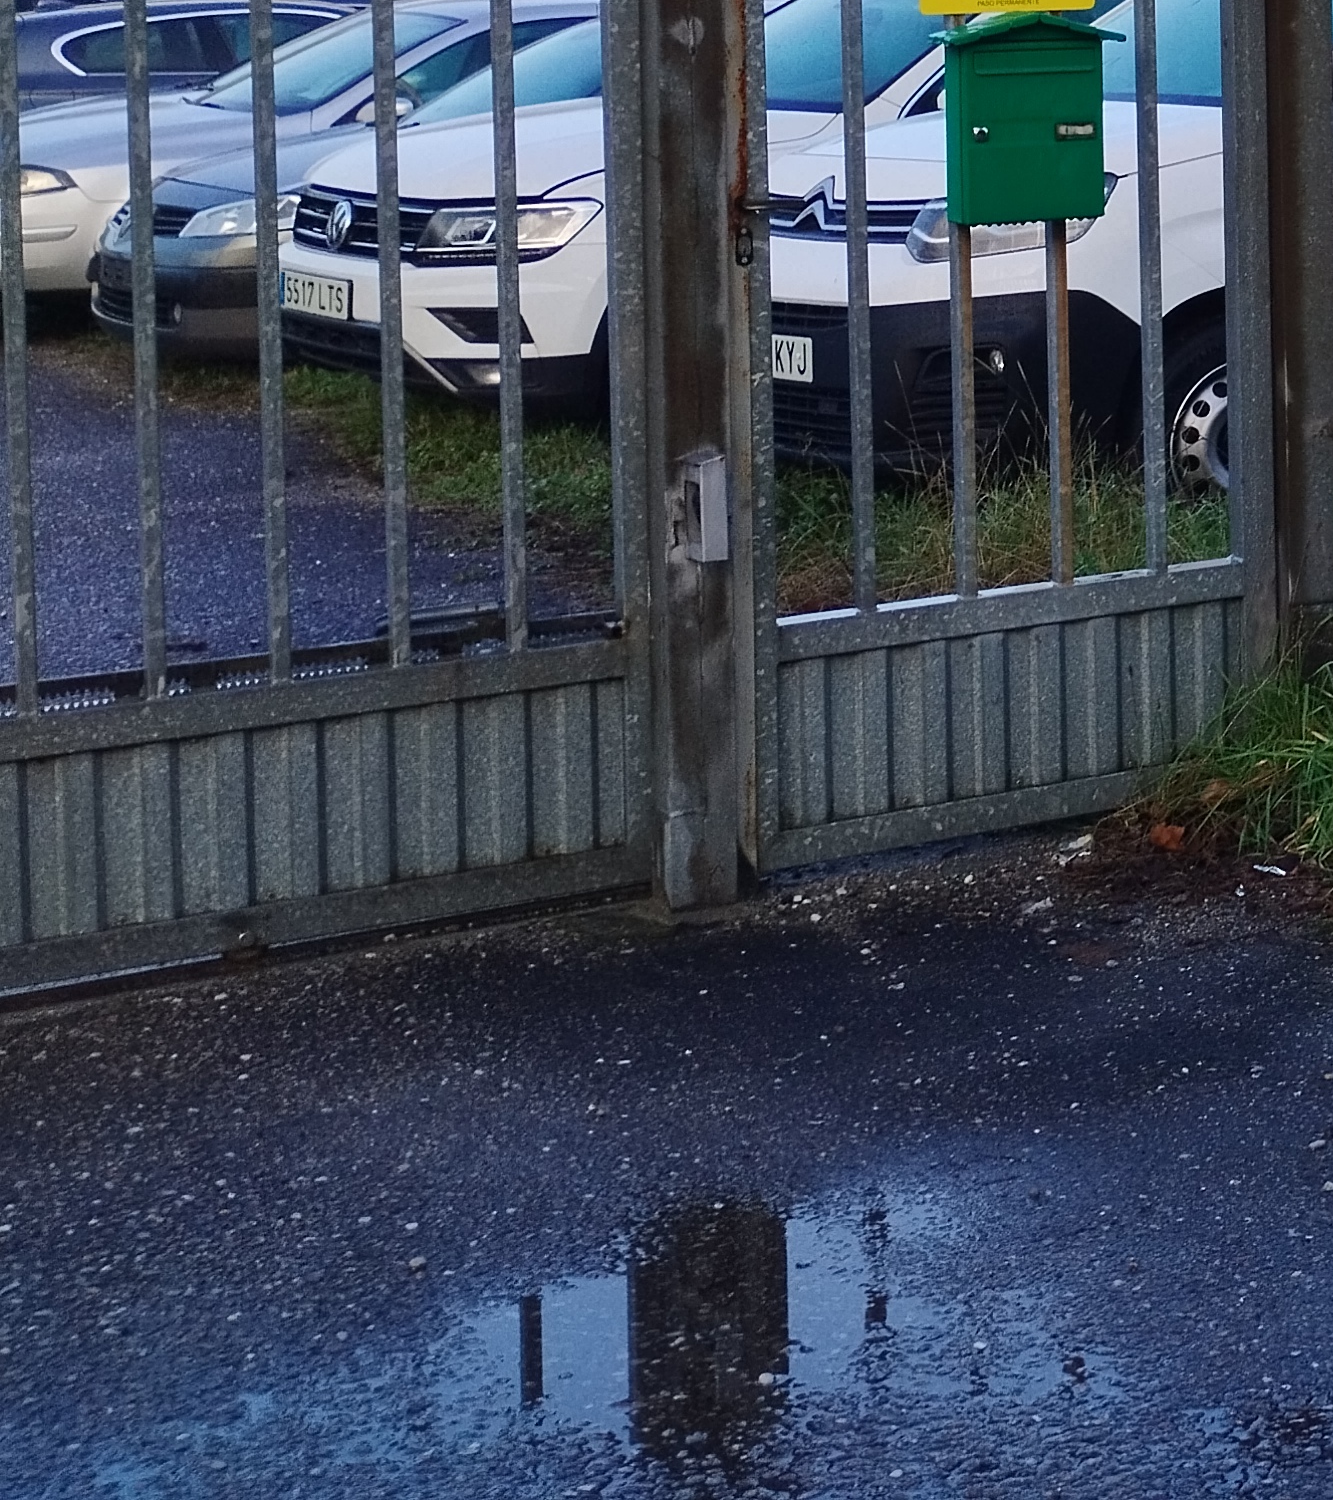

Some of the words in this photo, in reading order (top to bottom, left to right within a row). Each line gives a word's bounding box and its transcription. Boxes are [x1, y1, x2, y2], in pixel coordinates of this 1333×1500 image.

[287, 277, 314, 308] 5517
[318, 283, 344, 313] LTS
[774, 339, 807, 376] KYJ
